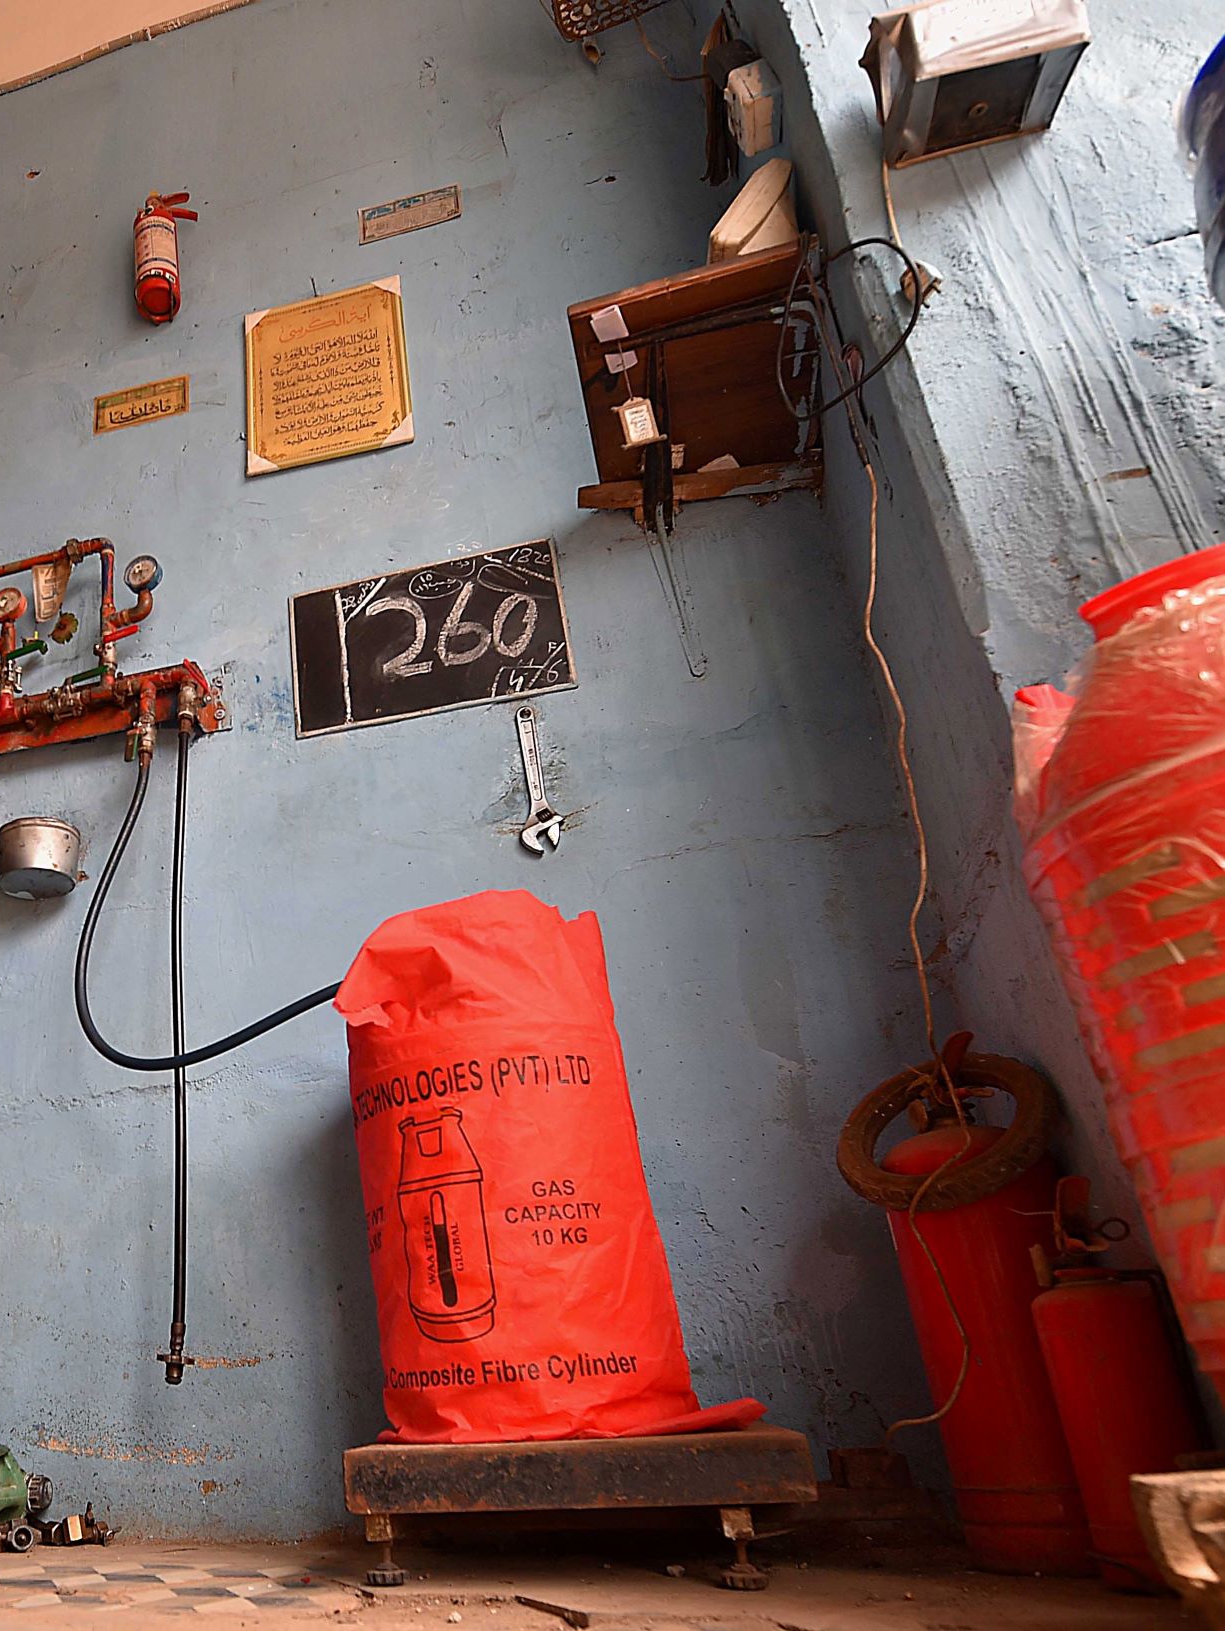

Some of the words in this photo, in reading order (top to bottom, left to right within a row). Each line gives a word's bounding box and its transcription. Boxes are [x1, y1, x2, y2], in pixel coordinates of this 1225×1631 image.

[365, 581, 539, 678] 260
[490, 1054, 550, 1098] (PVT)
[555, 1054, 591, 1085] LTD
[531, 1178, 576, 1198] GAS
[504, 1201, 602, 1225] CAPACITY
[450, 1221, 464, 1272] GLOBAL
[531, 1228, 554, 1246] 10
[559, 1226, 589, 1245] KG
[389, 1362, 476, 1392] Composite
[480, 1359, 541, 1385] Fibre
[547, 1350, 638, 1385] Cylinder
